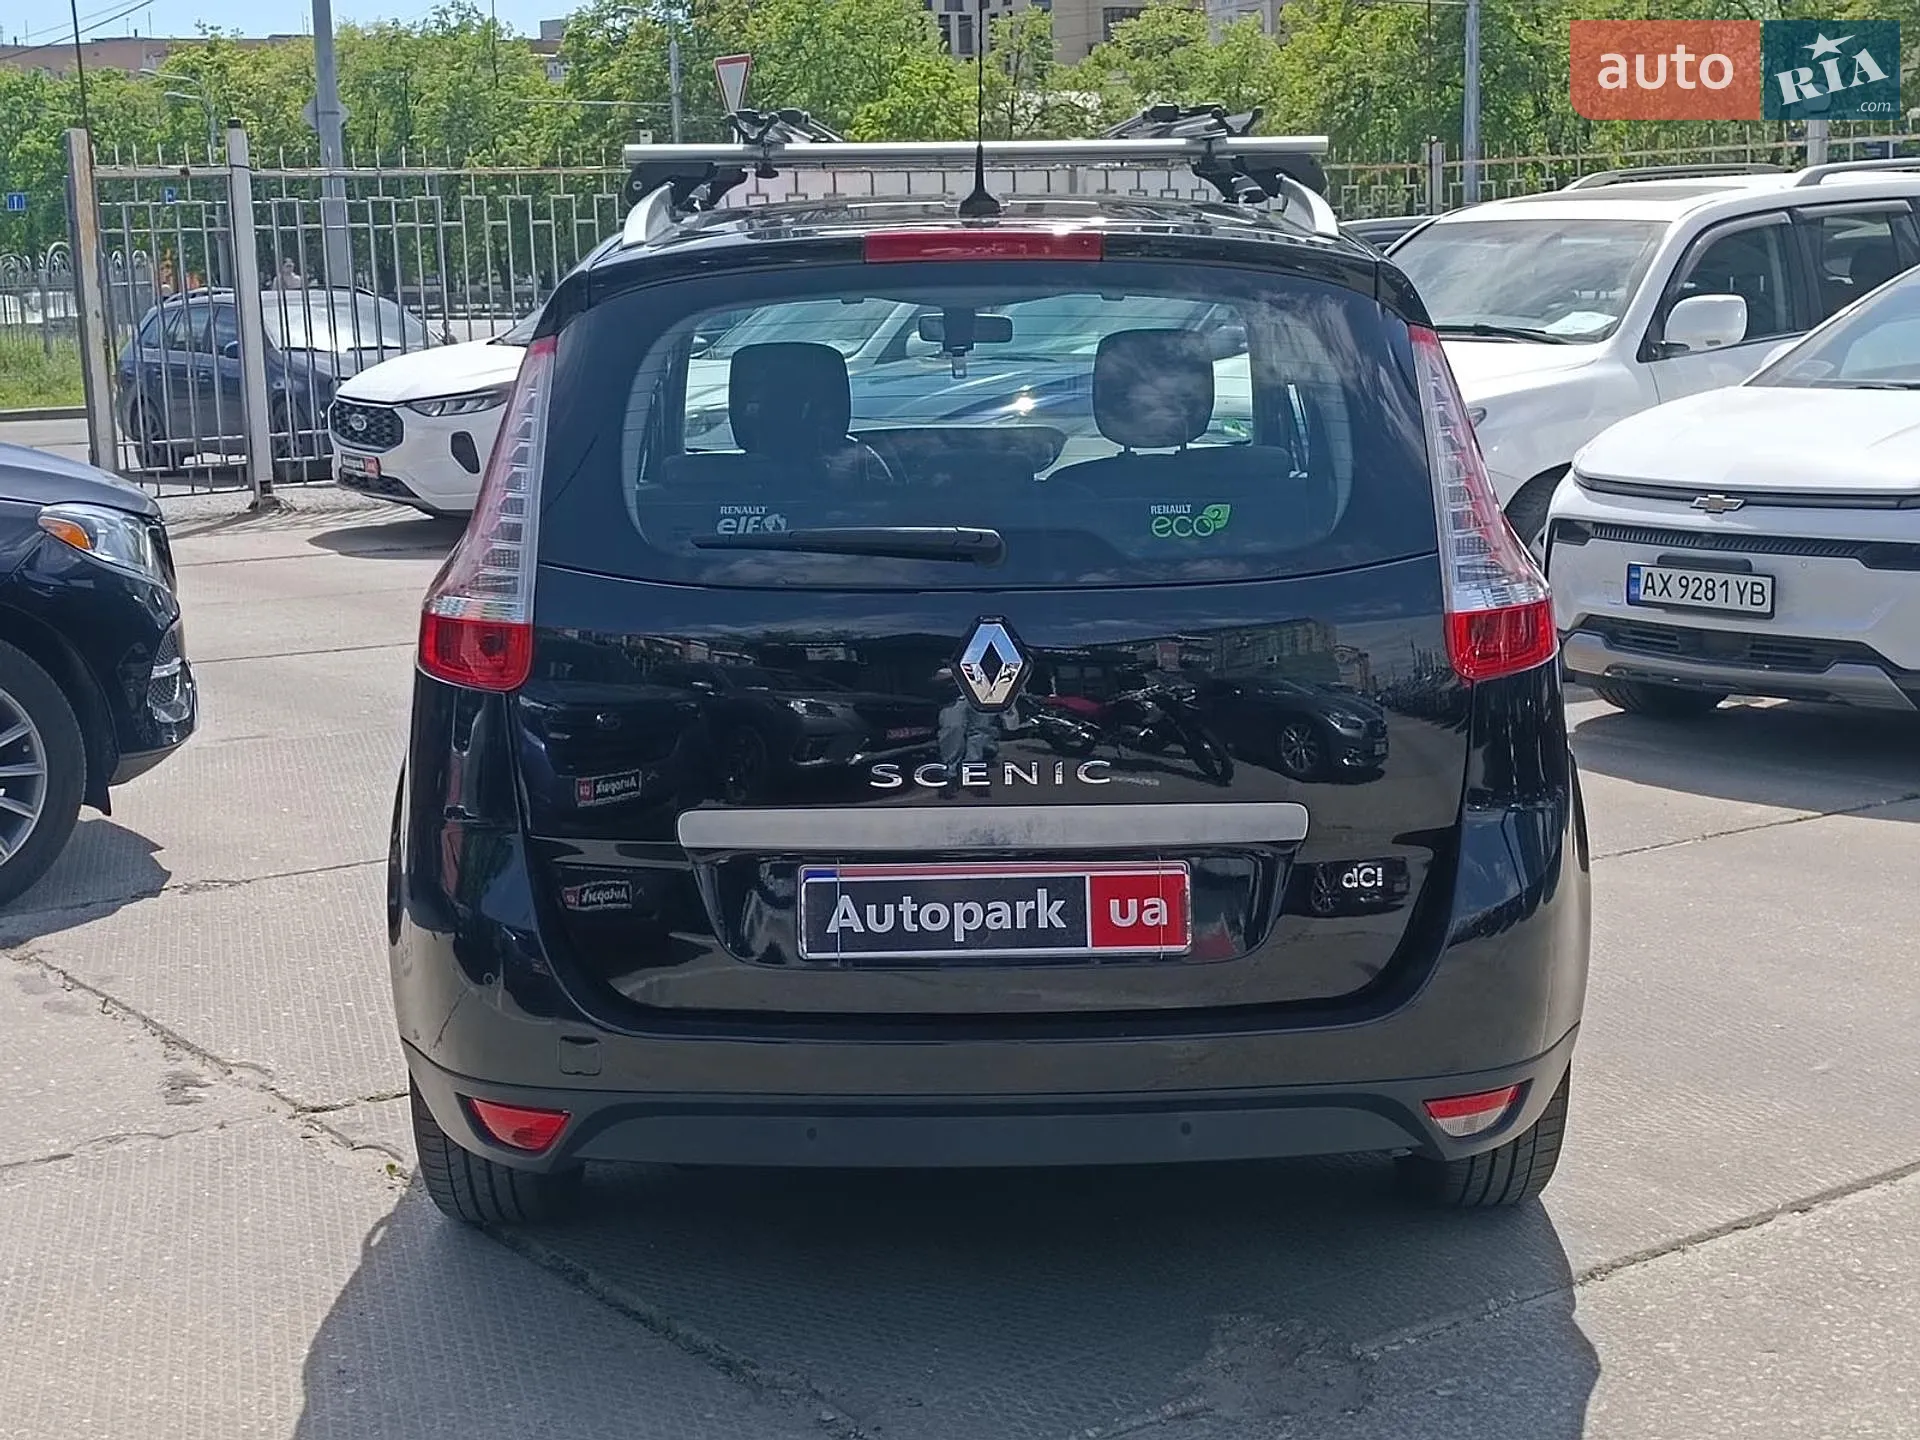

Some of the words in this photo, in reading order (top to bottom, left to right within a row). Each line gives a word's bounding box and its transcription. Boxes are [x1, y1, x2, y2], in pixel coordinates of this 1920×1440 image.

[720, 505, 767, 515] RENAULT
[1150, 504, 1192, 515] RENAULT
[1642, 572, 1673, 598] AX
[1678, 575, 1730, 604] 9281
[1736, 580, 1766, 607] YB
[870, 760, 1111, 788] SCENIC
[826, 888, 1067, 942] Autopark
[1109, 896, 1169, 927] ua
